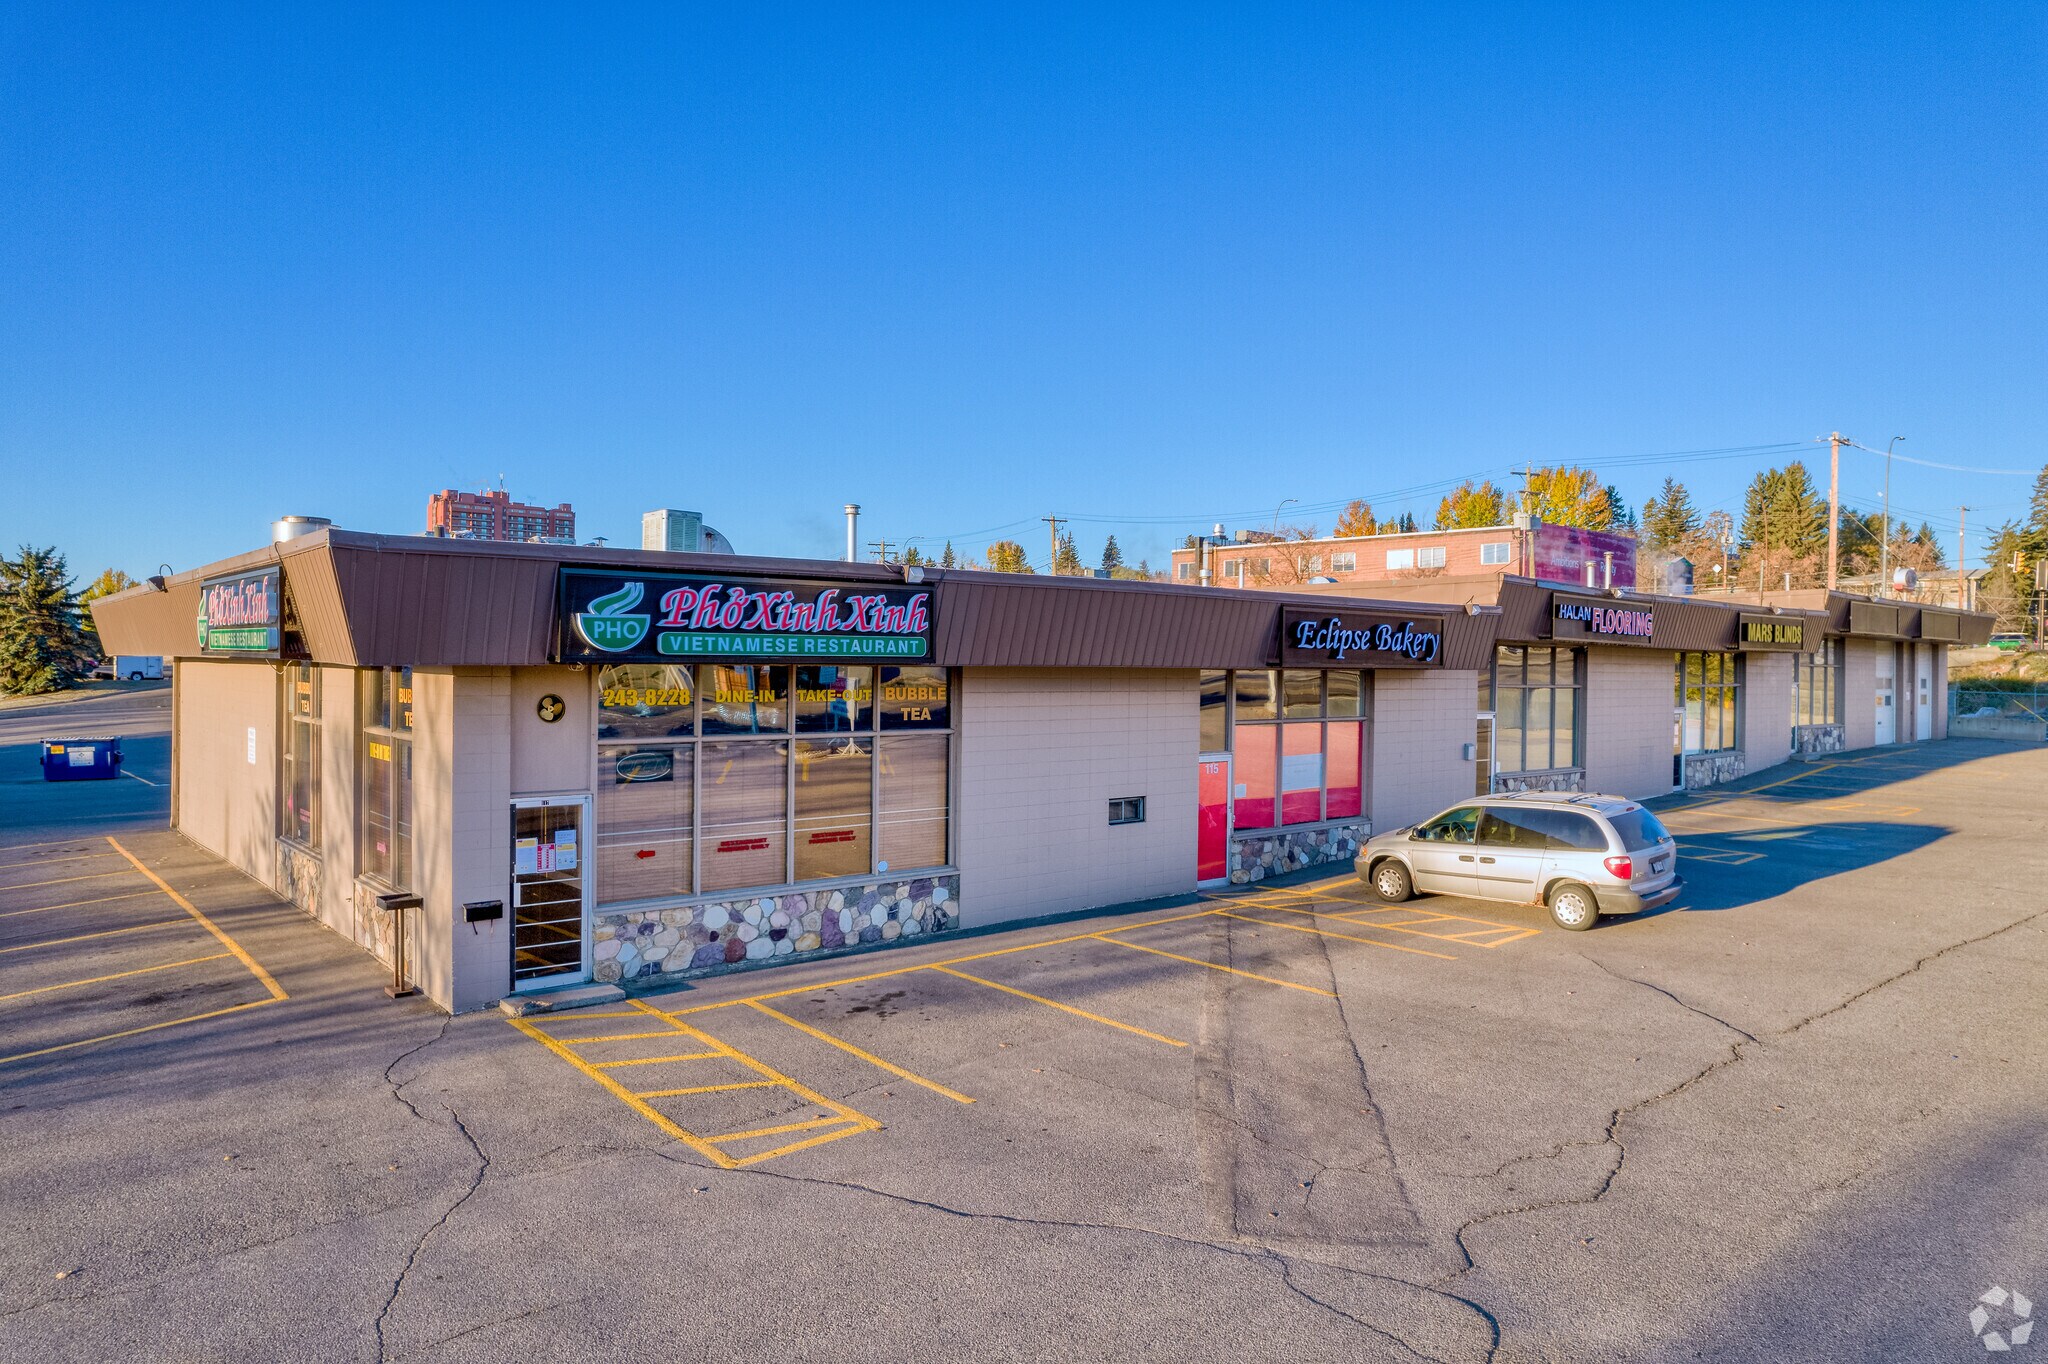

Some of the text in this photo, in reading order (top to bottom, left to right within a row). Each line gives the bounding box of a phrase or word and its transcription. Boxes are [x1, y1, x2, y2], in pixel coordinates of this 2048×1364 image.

[1550, 555, 1580, 569] Ambitions
[740, 589, 841, 632] Xinh
[839, 593, 929, 633] Xinh
[1559, 604, 1653, 637] HALAN FLOORING
[594, 620, 641, 639] PHO
[1748, 623, 1802, 644] MARS BLINDS
[670, 636, 919, 653] VIETNAMESE RESTAURANT
[1297, 617, 1440, 662] Eclipse Bakery
[603, 688, 690, 707] 243-8228
[715, 689, 776, 703] DINE-IN
[797, 689, 872, 702] TAKE-OUT
[885, 687, 947, 700] BUBBLE
[404, 711, 413, 727] TE
[901, 707, 931, 721] TEA
[1205, 763, 1219, 774] 115
